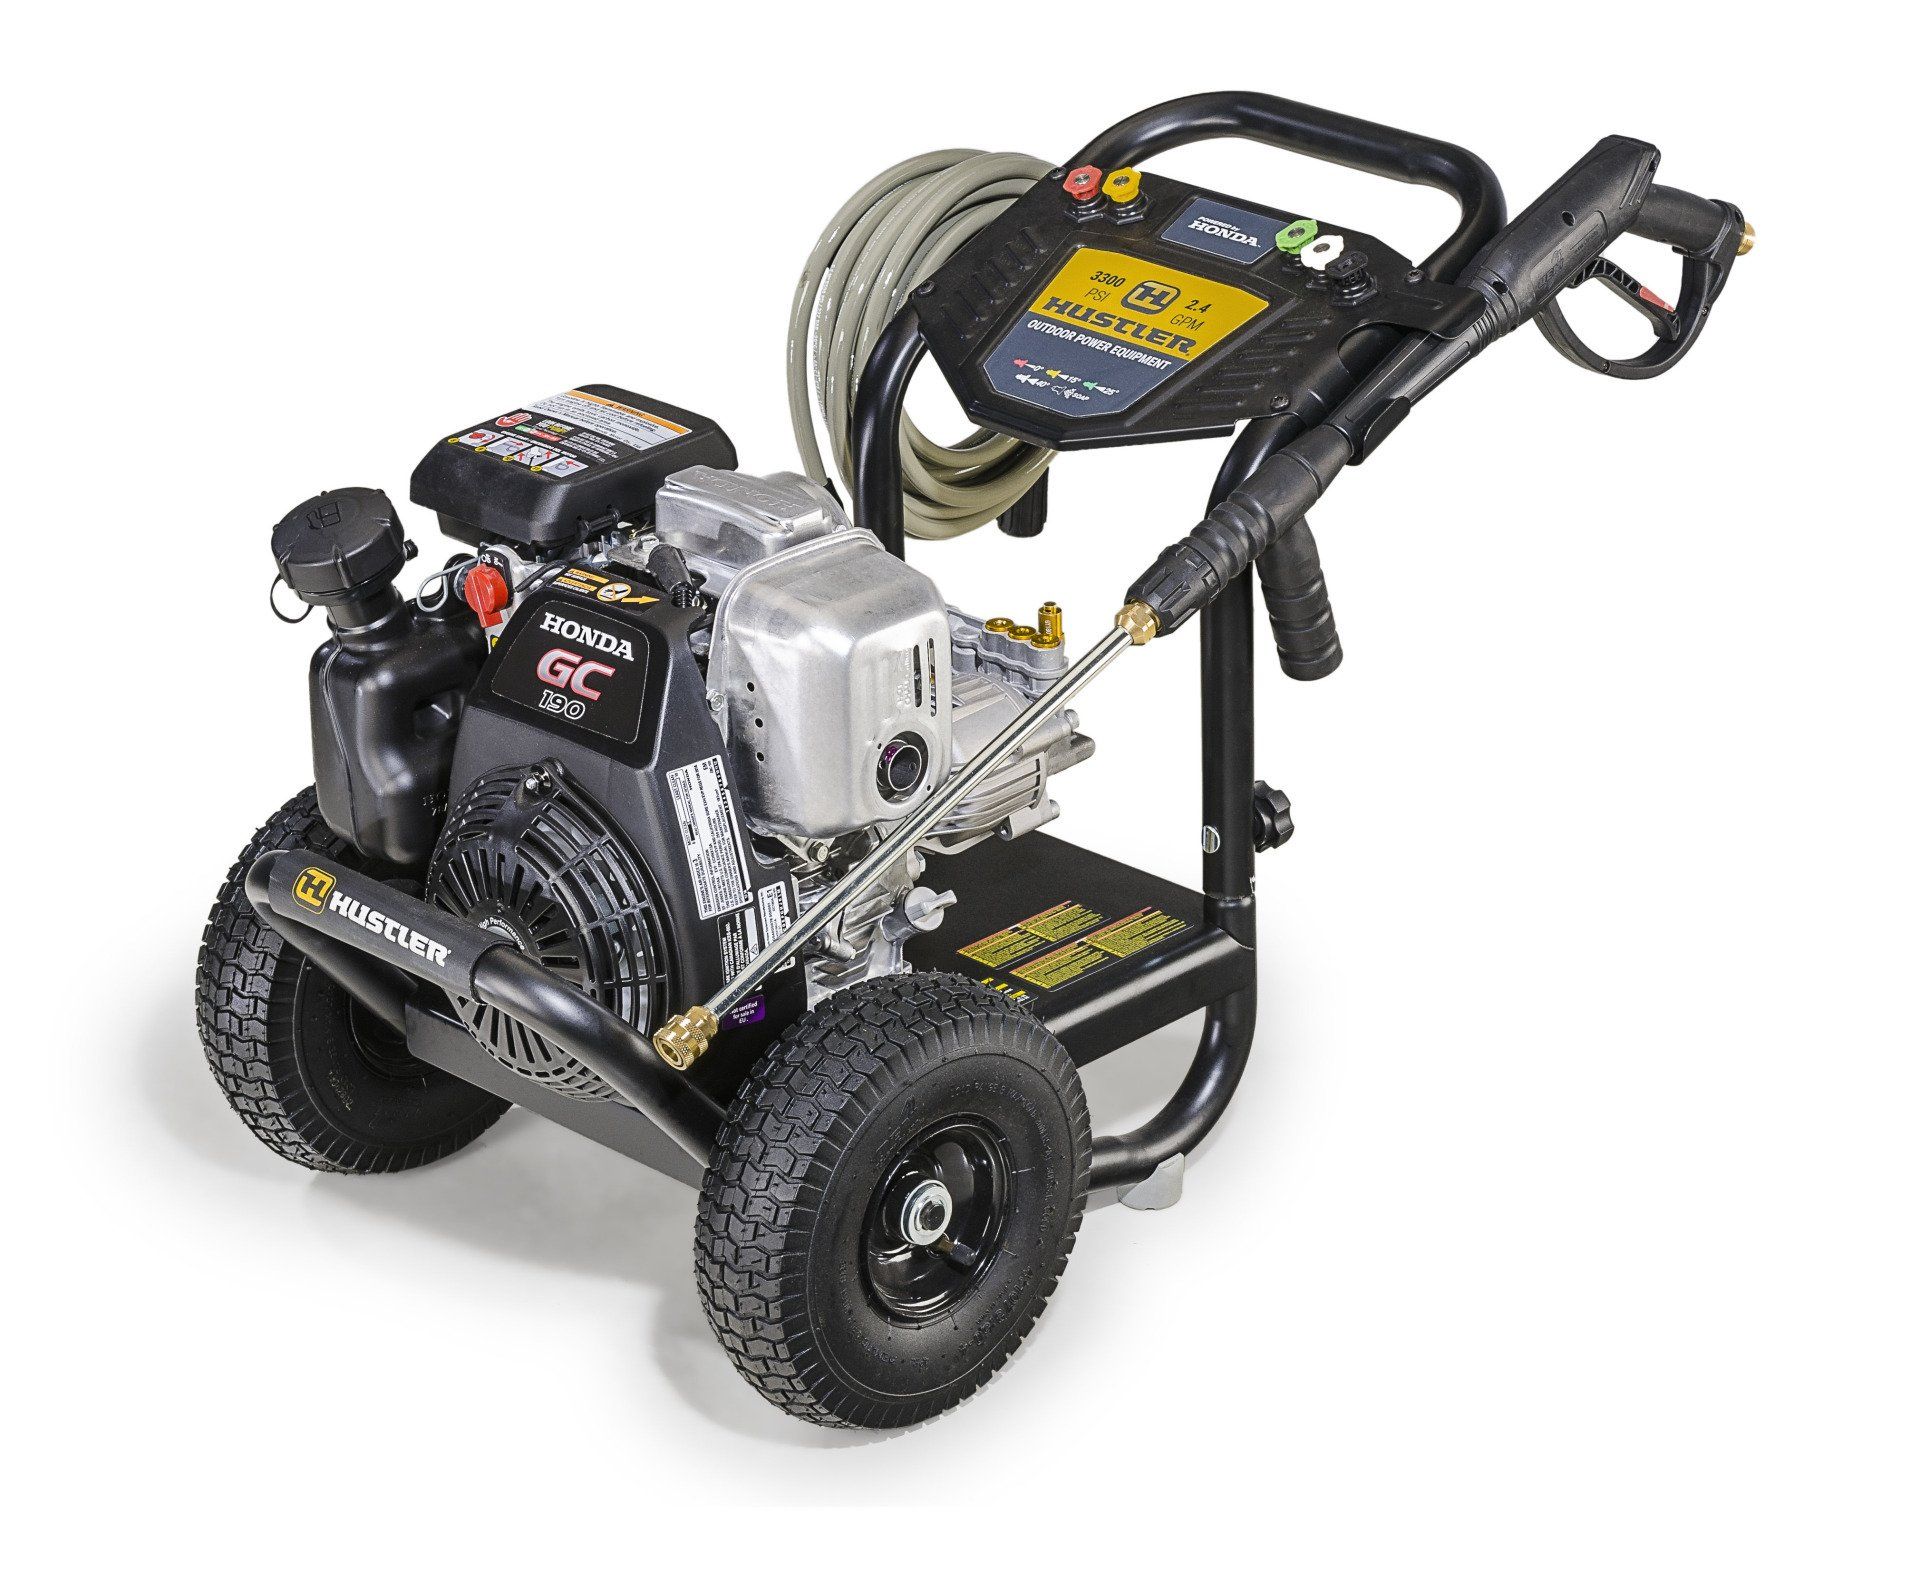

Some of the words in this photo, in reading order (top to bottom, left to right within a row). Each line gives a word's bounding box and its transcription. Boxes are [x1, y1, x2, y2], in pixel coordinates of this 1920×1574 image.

[1188, 220, 1258, 247] HONDA
[1198, 216, 1231, 228] POWERED
[1089, 271, 1126, 288] 3300
[1084, 287, 1111, 302] PSI
[1185, 300, 1212, 313] 2.4
[1042, 297, 1197, 353] HUSTLER
[1170, 314, 1205, 331] GPM
[1027, 319, 1074, 341] OUTDOOR
[1074, 334, 1113, 352] POWER
[1110, 345, 1172, 371] EQUIPMENT
[539, 612, 635, 662] HONDA
[537, 648, 616, 701] GC
[538, 689, 586, 720] 190
[329, 890, 449, 967] HUSTLER
[490, 917, 525, 950] Performance
[739, 1001, 758, 1011] certified
